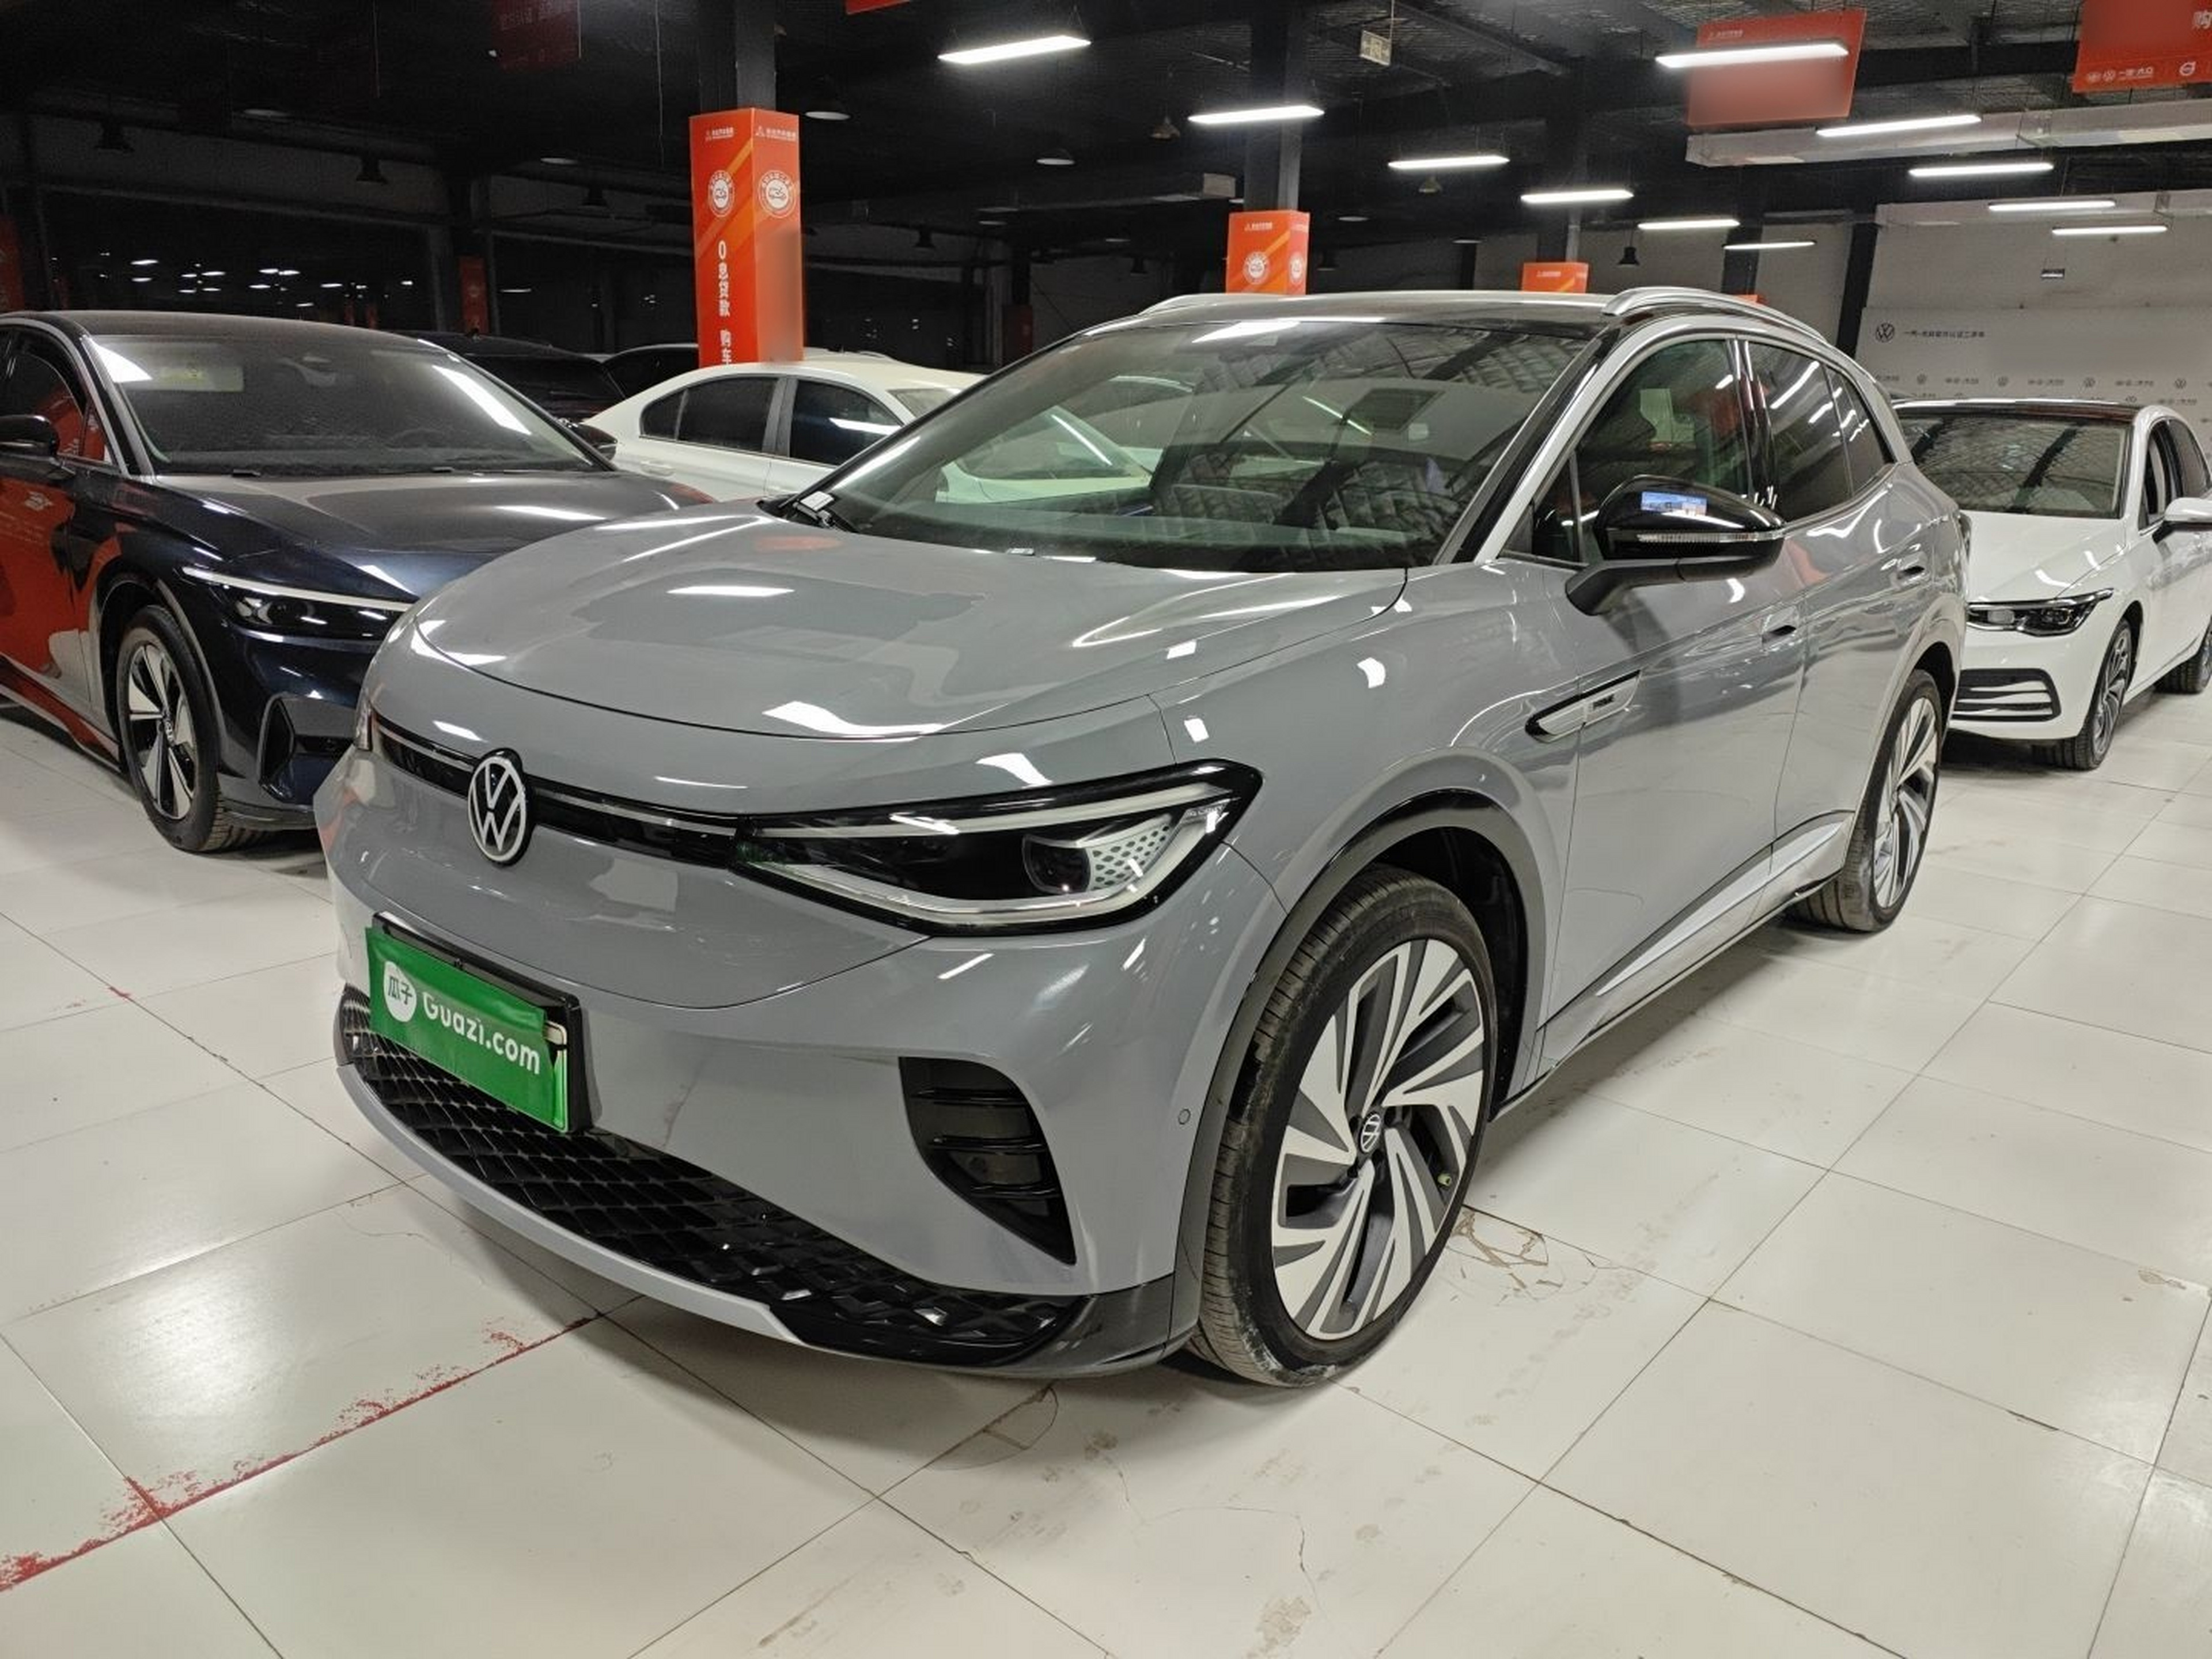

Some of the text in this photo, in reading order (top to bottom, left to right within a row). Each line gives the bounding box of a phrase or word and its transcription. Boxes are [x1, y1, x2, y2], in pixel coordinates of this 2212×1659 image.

[468, 756, 527, 861] VW
[387, 976, 413, 1005] 瓜子
[422, 992, 540, 1075] Guazi.com
